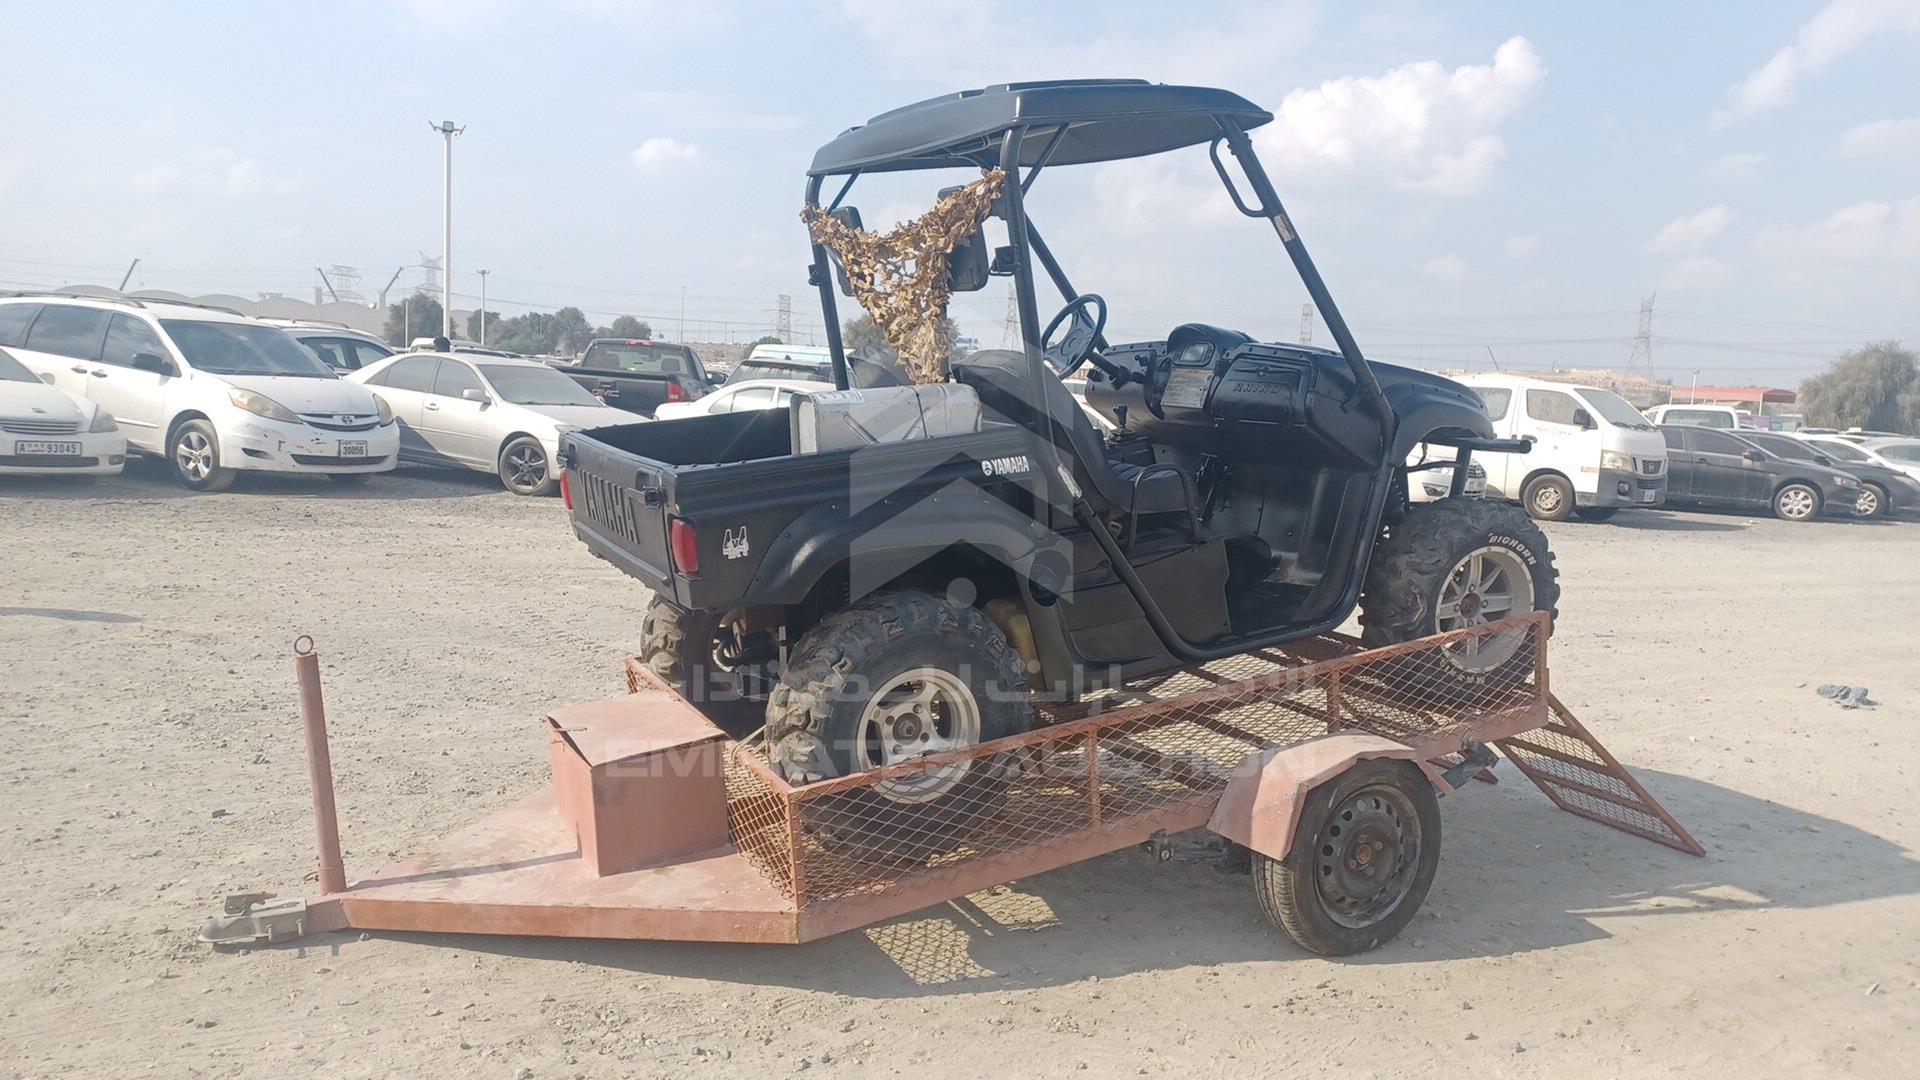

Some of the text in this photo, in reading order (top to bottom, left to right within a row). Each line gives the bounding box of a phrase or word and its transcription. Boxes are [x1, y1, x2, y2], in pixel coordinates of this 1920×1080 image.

[47, 443, 77, 453] 93045
[991, 455, 1030, 475] YAMAHA
[578, 468, 640, 545] YAMAHA
[1488, 532, 1537, 566] BIGHORN
